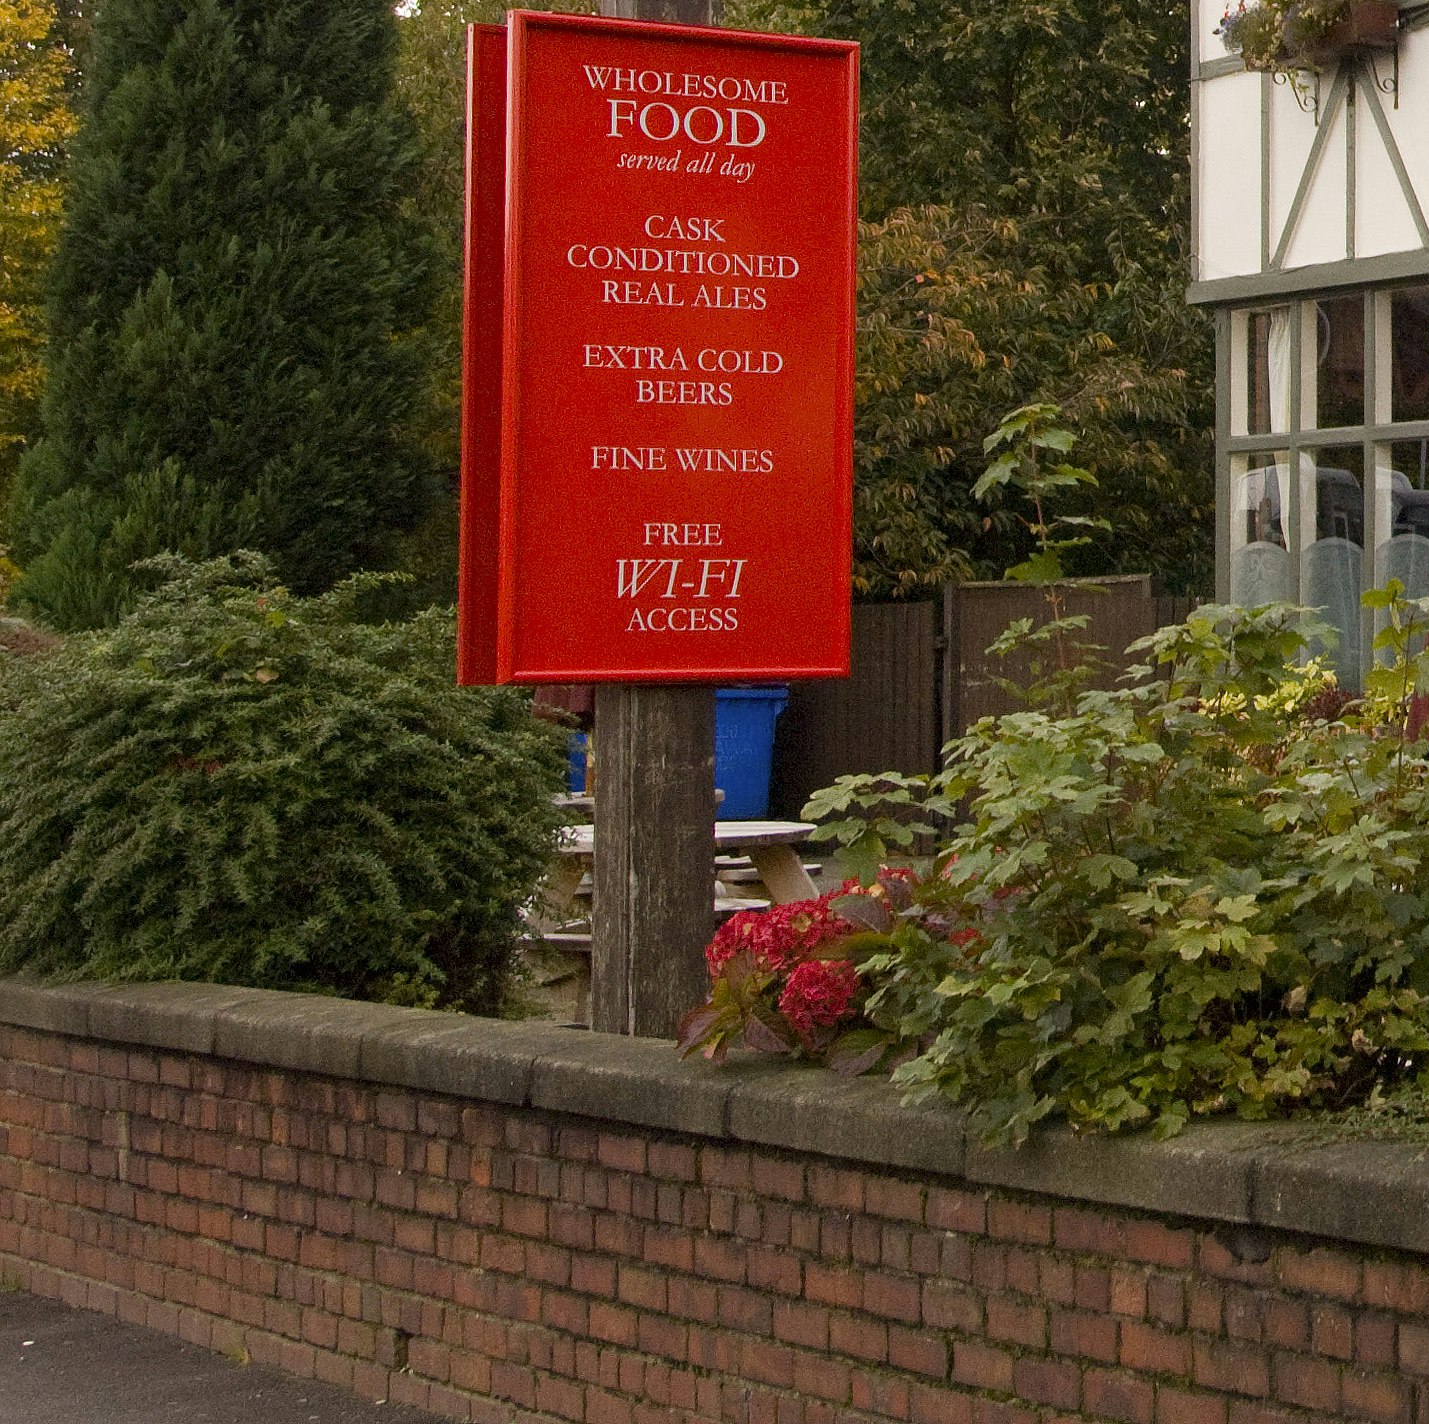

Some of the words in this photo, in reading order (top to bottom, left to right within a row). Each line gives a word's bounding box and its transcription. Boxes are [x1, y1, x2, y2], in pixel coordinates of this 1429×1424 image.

[582, 64, 789, 106] WHOLESOME
[605, 98, 767, 149] FOOD
[616, 149, 682, 173] served
[686, 152, 716, 176] all
[719, 155, 757, 184] day
[643, 214, 727, 244] CASK
[566, 244, 801, 281] CONDITIONED
[601, 280, 686, 309] REAL
[691, 285, 768, 312] ALES
[582, 344, 689, 372] EXTRA
[697, 348, 784, 375] COLD
[635, 380, 734, 407] BEERS
[591, 446, 668, 473] FINE
[674, 448, 775, 474] WINES
[643, 522, 723, 547] FREE
[615, 559, 748, 600] WI-FI
[625, 607, 739, 633] ACCESS
